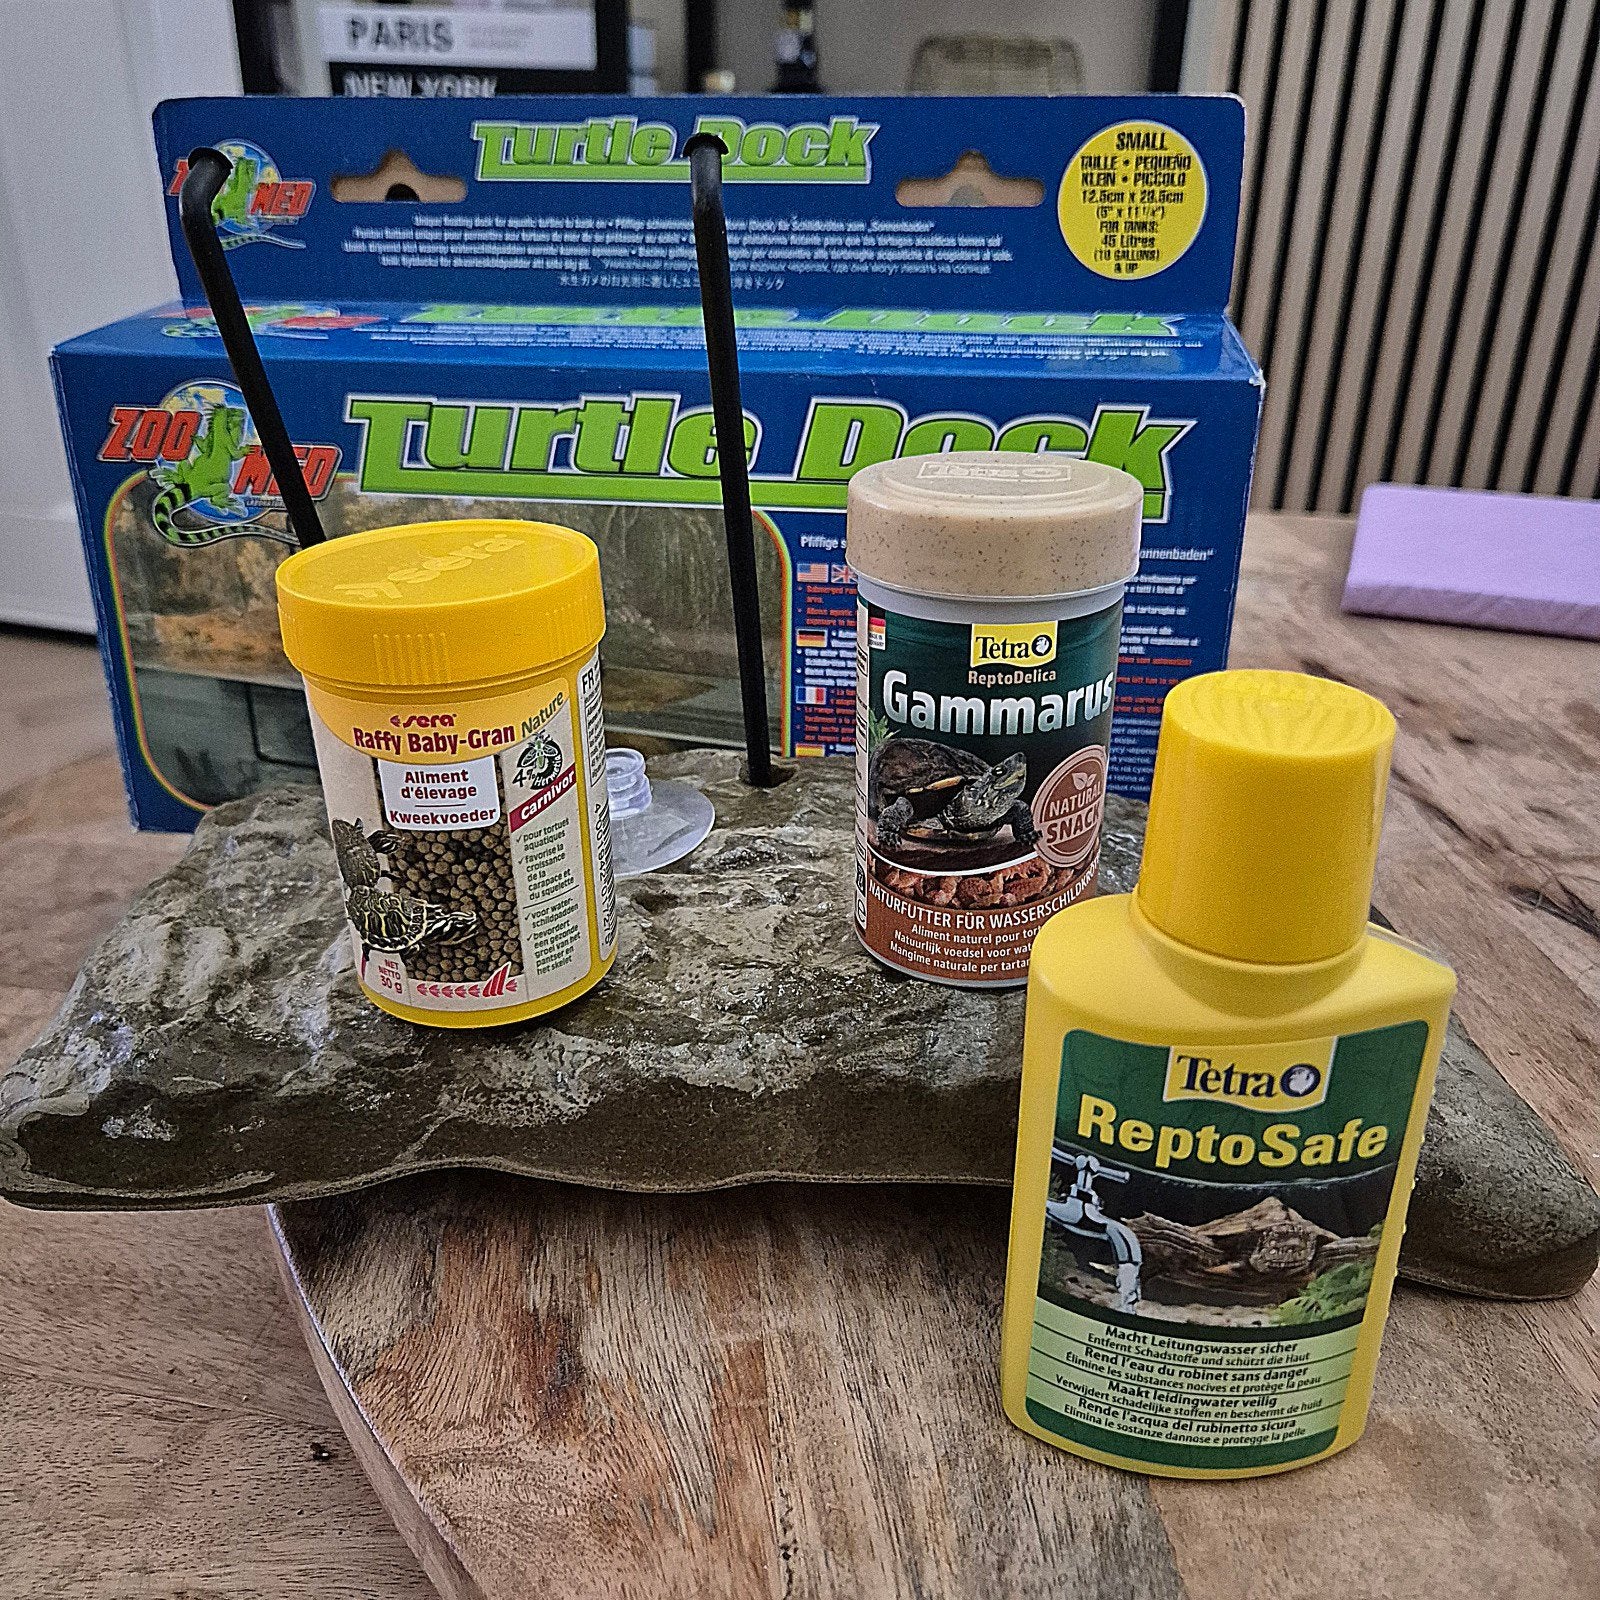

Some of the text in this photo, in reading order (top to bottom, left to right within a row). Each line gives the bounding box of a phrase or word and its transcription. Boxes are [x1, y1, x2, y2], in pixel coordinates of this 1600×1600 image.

[348, 17, 453, 51] PARIS
[473, 115, 880, 175] Turtle Dock
[1116, 132, 1168, 150] SMALL
[1133, 172, 1186, 187] PICCOLO
[248, 179, 316, 217] MED
[97, 405, 204, 462] ZOO
[344, 391, 762, 490] Turtle
[230, 442, 342, 500] MD
[975, 636, 1030, 659] Tetra
[582, 668, 594, 694] FR
[968, 669, 1056, 688] ReptoDelica
[883, 670, 1114, 735] Gammarus
[353, 691, 564, 755] Raffy Baby-Gran Nature
[403, 714, 455, 728] sera
[404, 769, 469, 784] Aliment
[401, 786, 477, 800] d'élevage
[1049, 781, 1101, 817] NATURAL
[390, 809, 496, 825] Kweekvoeder
[523, 817, 570, 844] pour tortues
[1047, 803, 1100, 844] SNACK
[523, 829, 566, 852] aquatiques
[525, 846, 557, 864] favorise
[526, 852, 566, 873] croissance
[527, 870, 546, 882] de la
[528, 868, 571, 892] carapace et
[529, 876, 574, 901] du squelette
[531, 906, 550, 919] voor
[532, 903, 579, 929] schildpadden
[869, 880, 951, 928] NATURFUTTER
[956, 912, 985, 930] FÜR
[533, 919, 570, 940] bevordert
[534, 924, 578, 949] een gezonde
[911, 924, 951, 942] Aliment
[953, 933, 992, 944] naturel
[995, 932, 1020, 945] pour
[890, 940, 931, 966] Mangime
[933, 959, 978, 973] naturale
[980, 961, 997, 974] per
[894, 930, 941, 955] Natuurlijk
[943, 946, 984, 958] voedsel
[987, 948, 1010, 958] voor
[536, 950, 564, 968] pantser
[380, 975, 392, 989] 30
[1177, 1055, 1273, 1098] Tetra
[1077, 1094, 1389, 1168] ReptoSafe
[1087, 1333, 1310, 1366] Entfernt Schadstoffe und schützt die Haut
[1105, 1326, 1297, 1356] Macht Leitungswasser sicher
[1066, 1350, 1321, 1395] Élimine les substances nocives et protège la peau
[1084, 1346, 1119, 1366] Rend
[1157, 1364, 1175, 1378] du
[1178, 1367, 1228, 1381] robinet
[1231, 1372, 1260, 1382] sans
[1263, 1366, 1308, 1380] danger
[1056, 1373, 1322, 1419] Verwijdert schadelijke stoffen en beschermt de huid
[1108, 1380, 1277, 1409] Maakt leidingwater veilig
[1064, 1404, 1102, 1426] Elimina
[1104, 1418, 1115, 1429] le
[1117, 1422, 1163, 1438] sostanze
[1165, 1430, 1211, 1444] dannose
[1222, 1434, 1269, 1447] protegge
[1271, 1431, 1280, 1441] la
[1282, 1427, 1306, 1443] pelle
[1078, 1397, 1119, 1418] Rende
[1172, 1419, 1193, 1432] del
[1196, 1421, 1258, 1434] rubinetto
[1261, 1419, 1296, 1432] sicura
